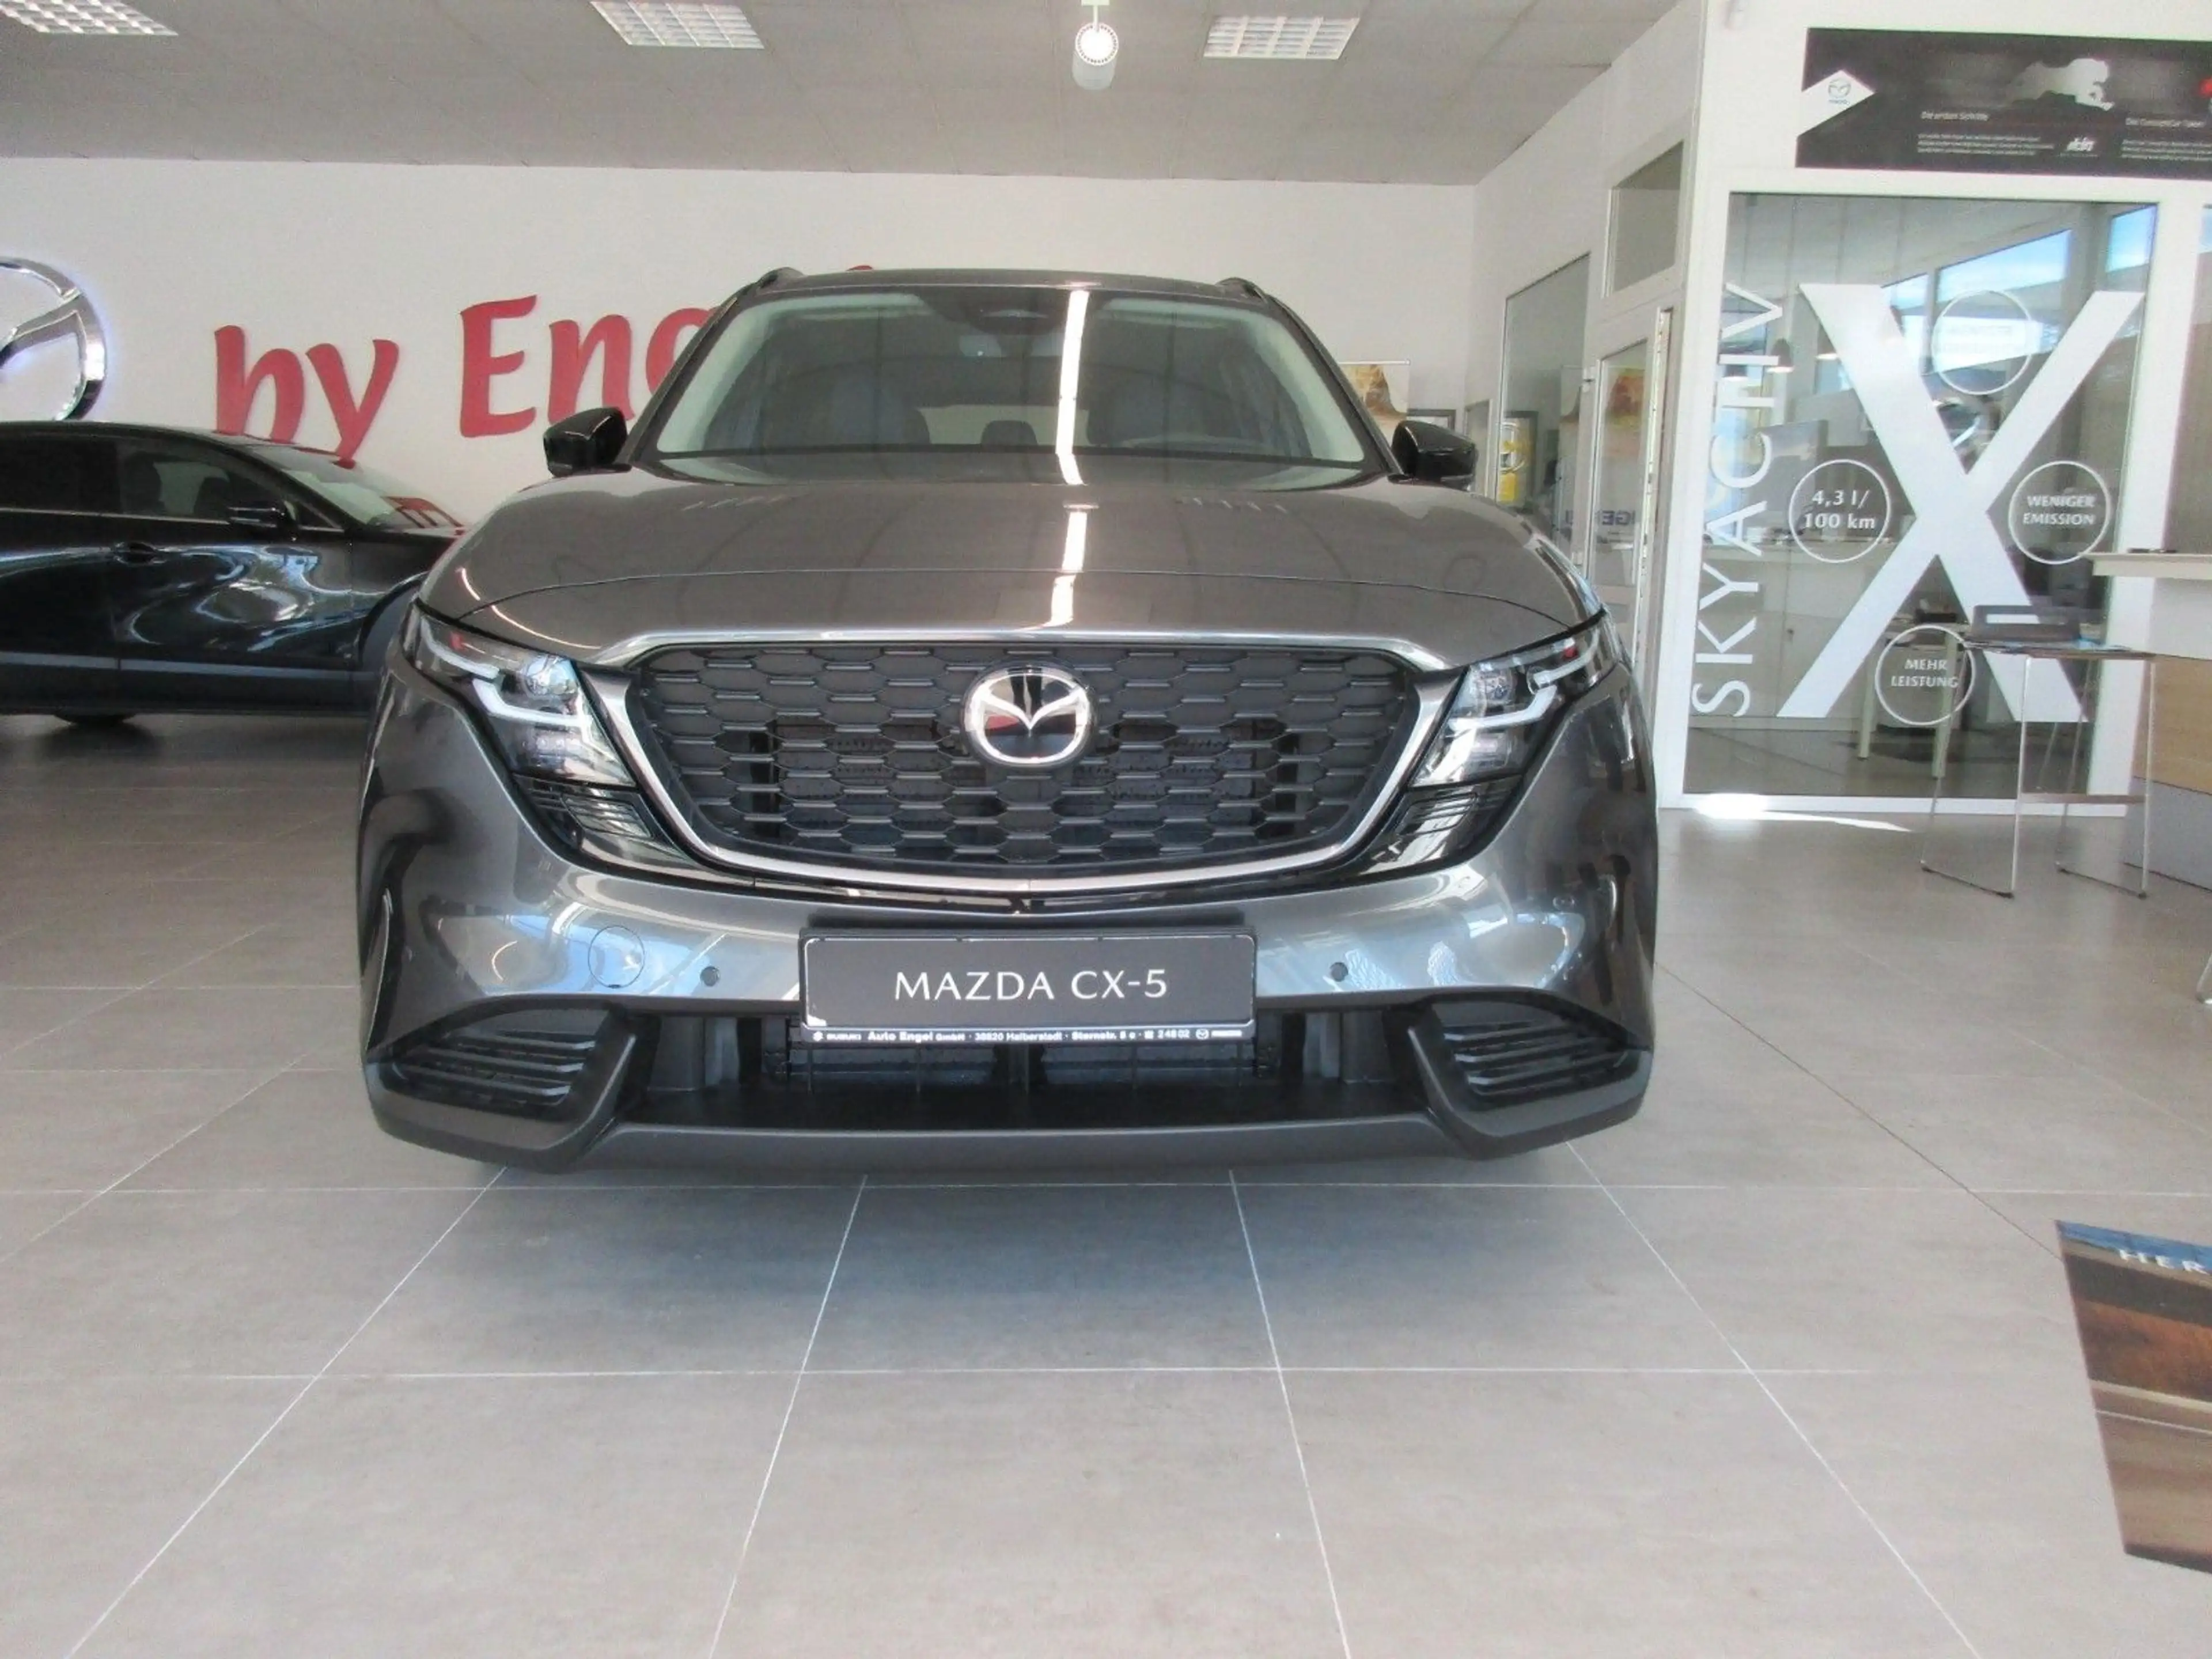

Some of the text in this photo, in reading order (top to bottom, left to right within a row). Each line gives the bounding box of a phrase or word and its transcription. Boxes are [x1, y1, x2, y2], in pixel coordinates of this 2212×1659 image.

[1692, 283, 1783, 717] SKYACTIV
[2027, 495, 2096, 508] WENIGER
[1805, 513, 1876, 529] 100 km
[2022, 512, 2096, 525] EMISSION
[1904, 658, 1948, 670] MEHR
[1891, 676, 1959, 688] LEISTUNG
[895, 969, 1168, 1001] MAZDA CX-5
[868, 1032, 896, 1041] Auto
[899, 1032, 933, 1043] Engel
[1006, 1031, 1062, 1041] Halberstadt
